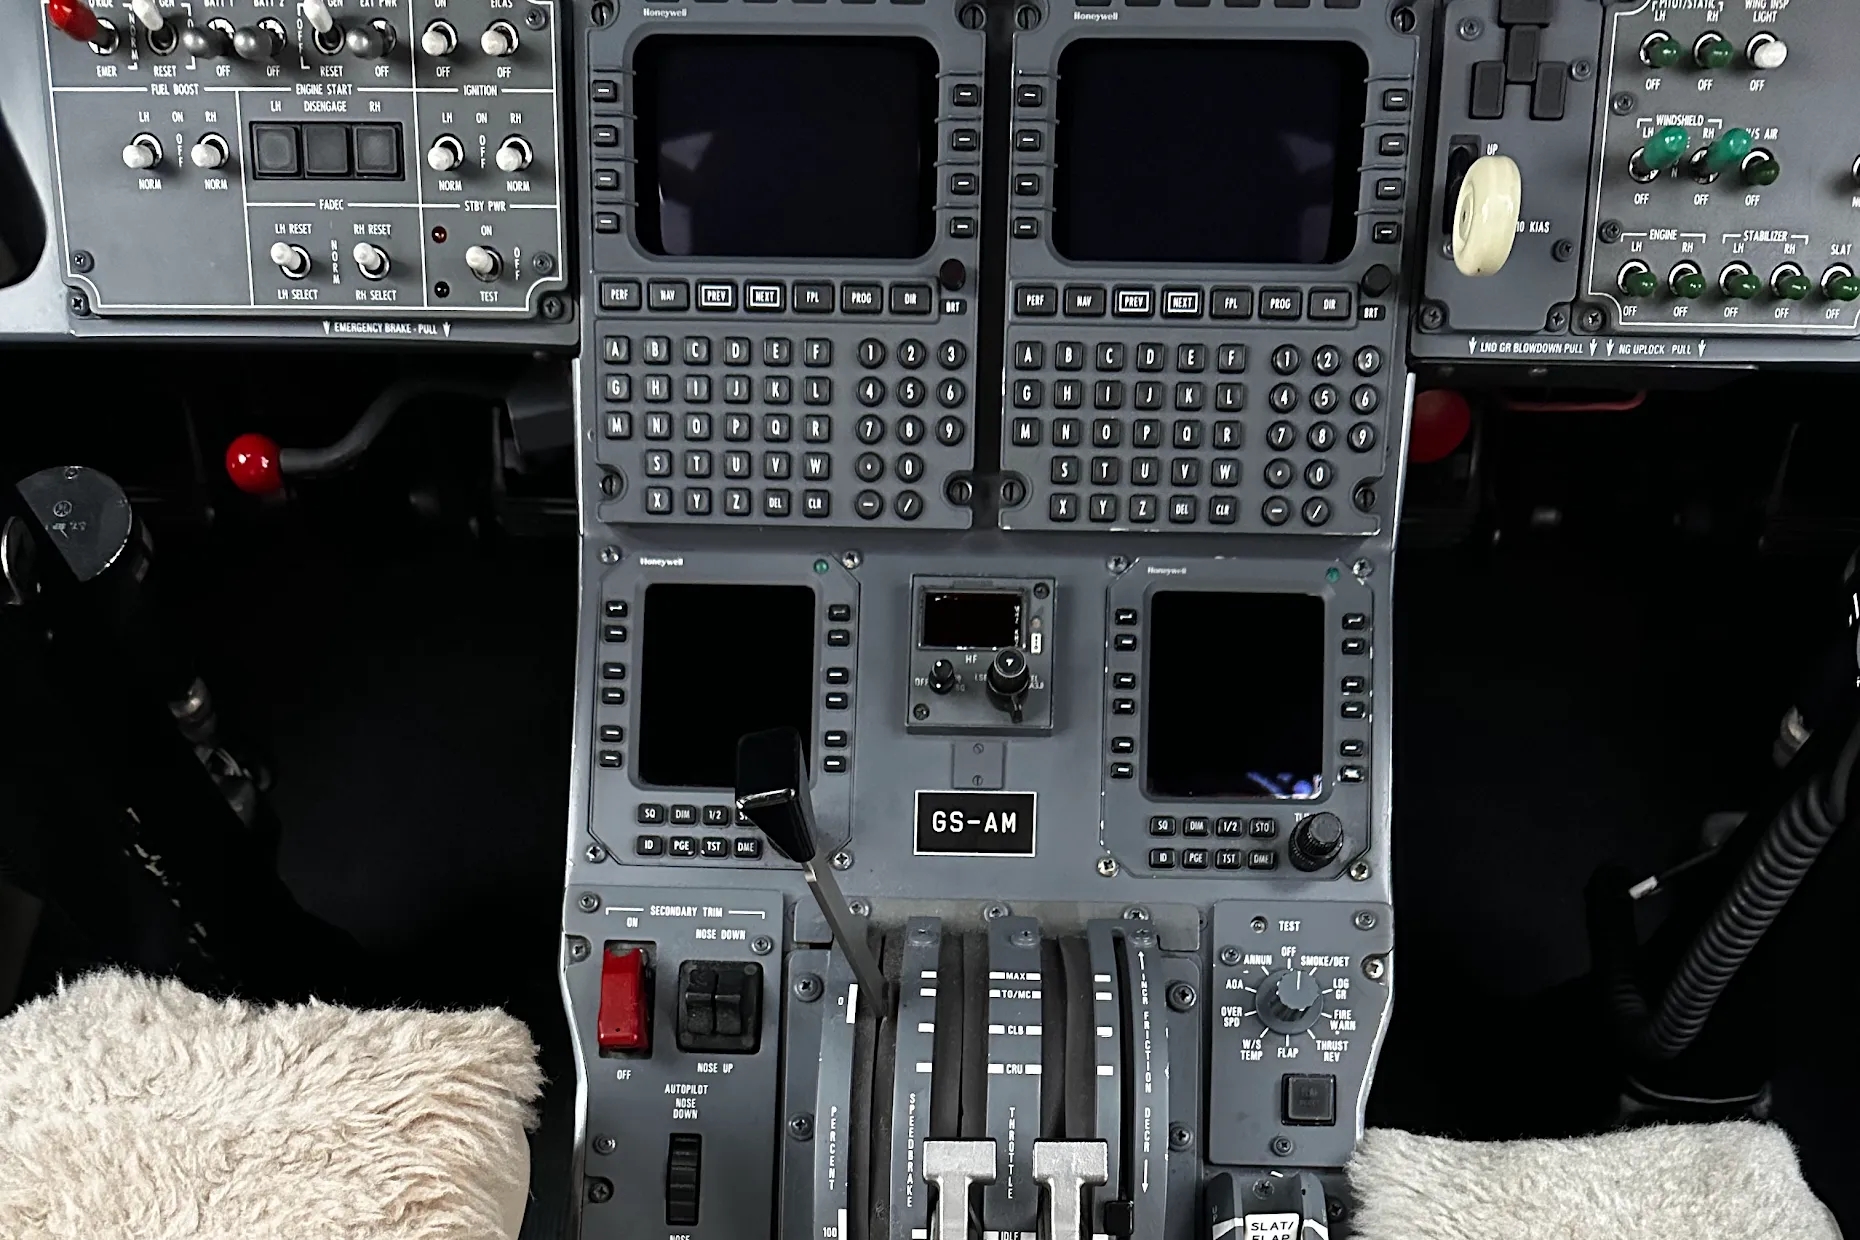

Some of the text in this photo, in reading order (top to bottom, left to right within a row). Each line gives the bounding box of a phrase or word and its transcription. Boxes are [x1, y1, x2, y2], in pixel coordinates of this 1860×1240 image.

[644, 8, 686, 18] Honeywell
[1753, 11, 1777, 22] LIGHT
[97, 66, 117, 77] EMER
[154, 65, 176, 77] RESET
[216, 65, 230, 77] OFF
[151, 84, 199, 95] FUEL BOOST
[296, 84, 352, 95] ENGINE START
[1646, 79, 1660, 90] OFF
[464, 85, 497, 96] IGNITION
[271, 101, 281, 112] LH
[304, 101, 346, 112] DISENGAGE
[139, 111, 149, 122] LH
[1657, 114, 1704, 126] WINDSHIELD
[1487, 144, 1498, 155] UP
[139, 179, 161, 189] NORM
[320, 199, 344, 210] FADEC
[465, 200, 506, 211] STBY PWR
[275, 224, 311, 234] LH RESET
[1650, 229, 1677, 240] ENGINE
[1744, 230, 1787, 241] STABILIZER
[1831, 244, 1852, 255] SLAT
[331, 240, 340, 284] NORM
[278, 289, 318, 300] LH SELECT
[356, 290, 396, 301] RH SELECT
[480, 291, 498, 302] TEST
[611, 289, 628, 300] PERF
[661, 290, 674, 300] NAV
[707, 291, 725, 301] PREV
[756, 291, 774, 302] NEXT
[852, 292, 871, 303] PROG
[946, 301, 959, 312] BRT
[1270, 298, 1290, 309] PROG
[335, 323, 438, 335] EMERGENCY BRAKE PULL
[612, 342, 698, 357] A B C
[908, 345, 914, 361] 2
[948, 346, 955, 361] 3
[1480, 342, 1583, 353] LND GR BLOWDOWN PULL
[1633, 345, 1665, 354] UPLOCK
[1672, 345, 1691, 354] PULL
[769, 497, 781, 508] DEL
[809, 498, 821, 509] CLR
[640, 558, 683, 567] Honeywell
[966, 654, 977, 663] HF
[645, 809, 655, 818] SQ
[676, 810, 690, 818] DIM
[709, 810, 721, 820] 1/2
[933, 811, 1016, 833] GS-AM
[1256, 821, 1270, 832] STO
[674, 841, 689, 850] PGE
[650, 905, 722, 917] SECONDARY TRIM
[627, 917, 638, 927] ON
[1279, 921, 1300, 931] TEST
[696, 929, 745, 940] NOSE DOWN
[1281, 946, 1296, 957] OFF
[1244, 955, 1272, 965] ANNUN
[1301, 956, 1349, 967] SMOKE/DET
[1006, 972, 1025, 980] MAX
[1226, 979, 1243, 989] AOA
[1002, 990, 1031, 998] TO/MC
[1221, 1006, 1242, 1016] OVER
[1334, 1009, 1351, 1019] FIRE
[1008, 1025, 1023, 1035] CLB
[1330, 1020, 1356, 1030] WARN
[1243, 1039, 1261, 1049] W/S
[1316, 1040, 1348, 1051] THRUST
[1240, 1050, 1263, 1060] TEMP
[1278, 1048, 1298, 1058] FLAP
[1324, 1052, 1340, 1062] REV
[697, 1063, 733, 1073] NOSE UP
[1006, 1064, 1022, 1074] CRU
[617, 1070, 631, 1080] OFF
[665, 1084, 708, 1094] AUTOPILOT
[829, 1106, 837, 1190] PERCENT
[907, 1093, 915, 1207] SPEEDBRAKE
[823, 1227, 837, 1237] 100
[1252, 1222, 1293, 1231] SLAT/
